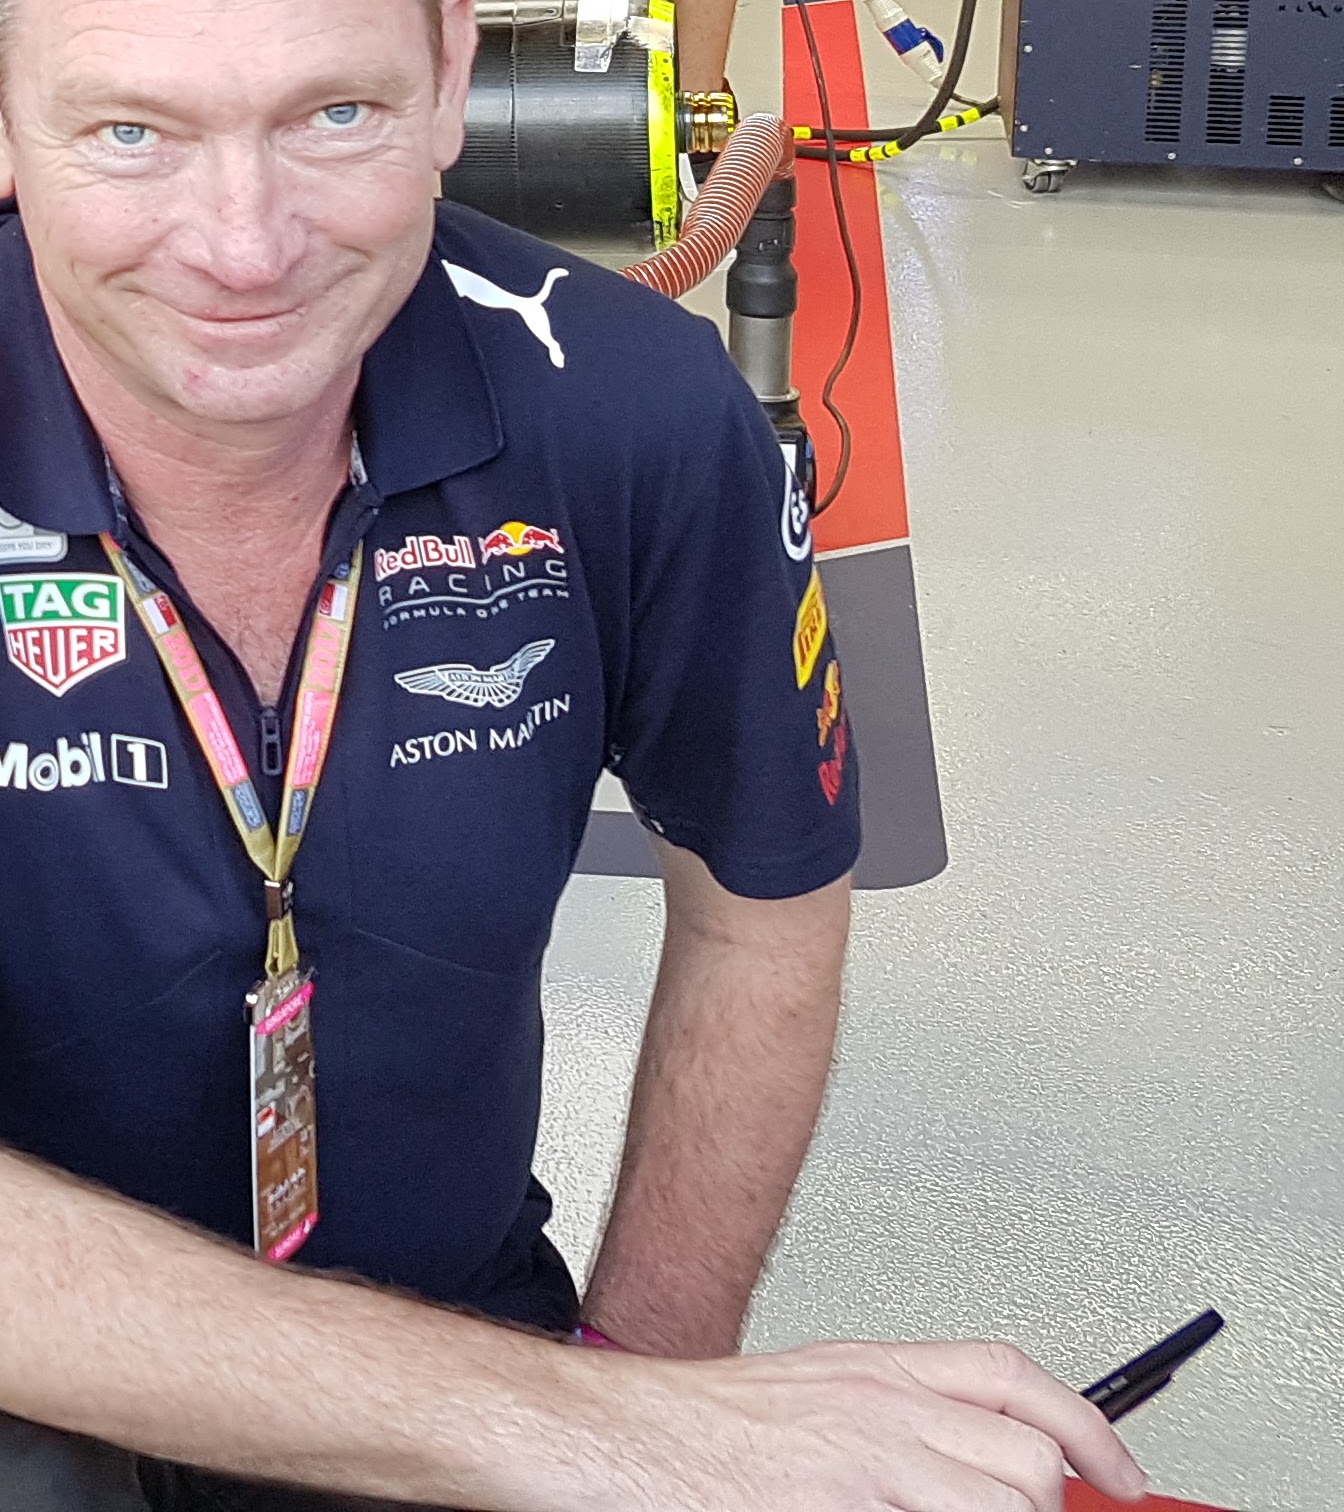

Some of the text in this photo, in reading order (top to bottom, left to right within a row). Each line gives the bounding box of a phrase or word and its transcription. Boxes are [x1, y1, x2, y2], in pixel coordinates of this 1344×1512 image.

[3, 583, 111, 619] TAG
[378, 560, 567, 606] RACING
[476, 599, 509, 619] ONE
[517, 588, 570, 602] TEAM
[10, 627, 115, 686] HEUER
[162, 632, 208, 689] 2017
[390, 728, 478, 768] ASTON
